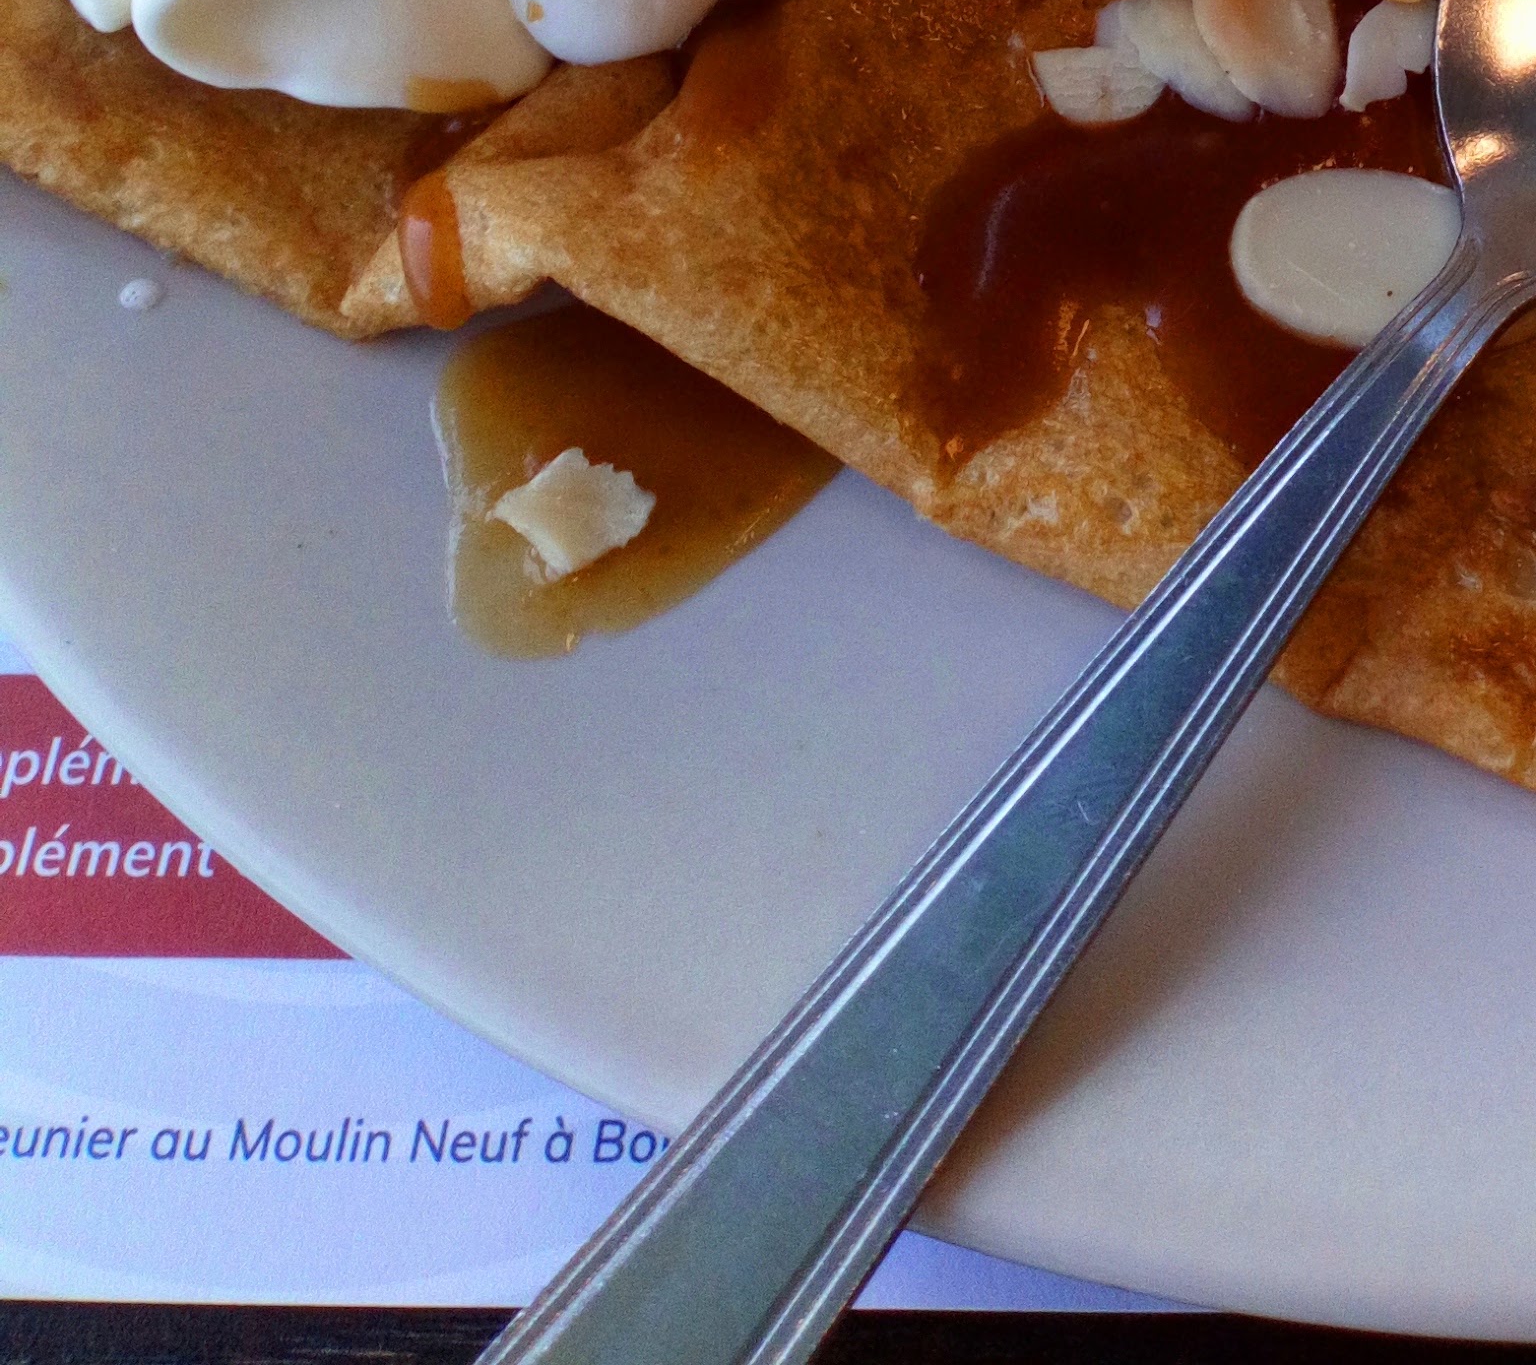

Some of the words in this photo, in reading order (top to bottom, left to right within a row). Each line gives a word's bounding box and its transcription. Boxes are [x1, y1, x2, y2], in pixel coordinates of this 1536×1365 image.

[150, 1127, 212, 1162] au
[228, 1116, 392, 1163] Moulin
[409, 1117, 533, 1164] Neuf
[543, 1115, 574, 1164] à
[592, 1119, 670, 1164] Bo
